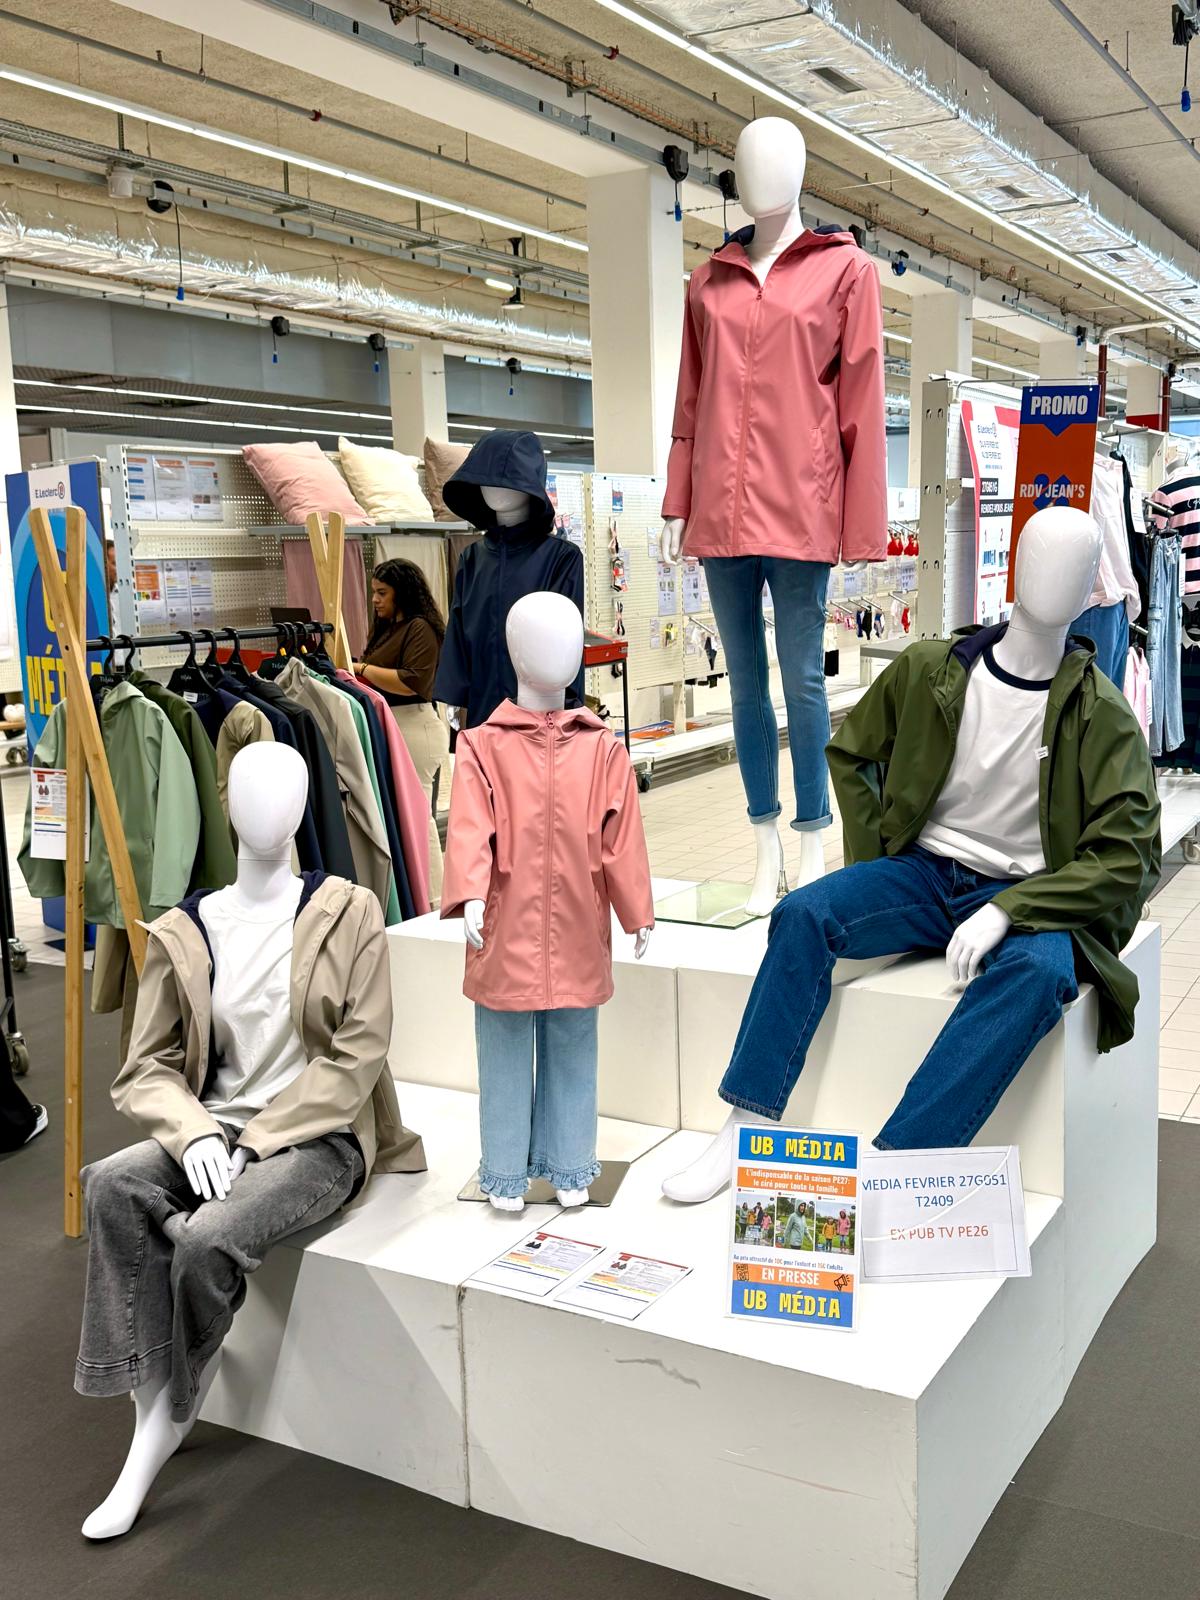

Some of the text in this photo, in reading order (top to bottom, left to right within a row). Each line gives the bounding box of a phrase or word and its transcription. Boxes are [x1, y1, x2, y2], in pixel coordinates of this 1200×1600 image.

[1030, 395, 1088, 416] PROMO
[1019, 484, 1086, 498] RDV JEAN'S
[750, 1135, 846, 1162] UB MÉDIA
[746, 1168, 793, 1181] L'indispensable
[794, 1171, 802, 1181] de
[803, 1172, 810, 1181] la
[811, 1174, 831, 1184] saison
[905, 1175, 956, 1189] FEVRIER
[753, 1178, 760, 1187] le
[774, 1181, 789, 1191] pour
[790, 1181, 807, 1192] toute
[808, 1183, 816, 1192] la
[816, 1183, 839, 1194] famille
[915, 1195, 954, 1208] T2409
[890, 1225, 989, 1240] EX PUB TV PE26
[761, 1268, 820, 1286] EN PRESSE
[743, 1288, 841, 1319] UB MÉDIA
